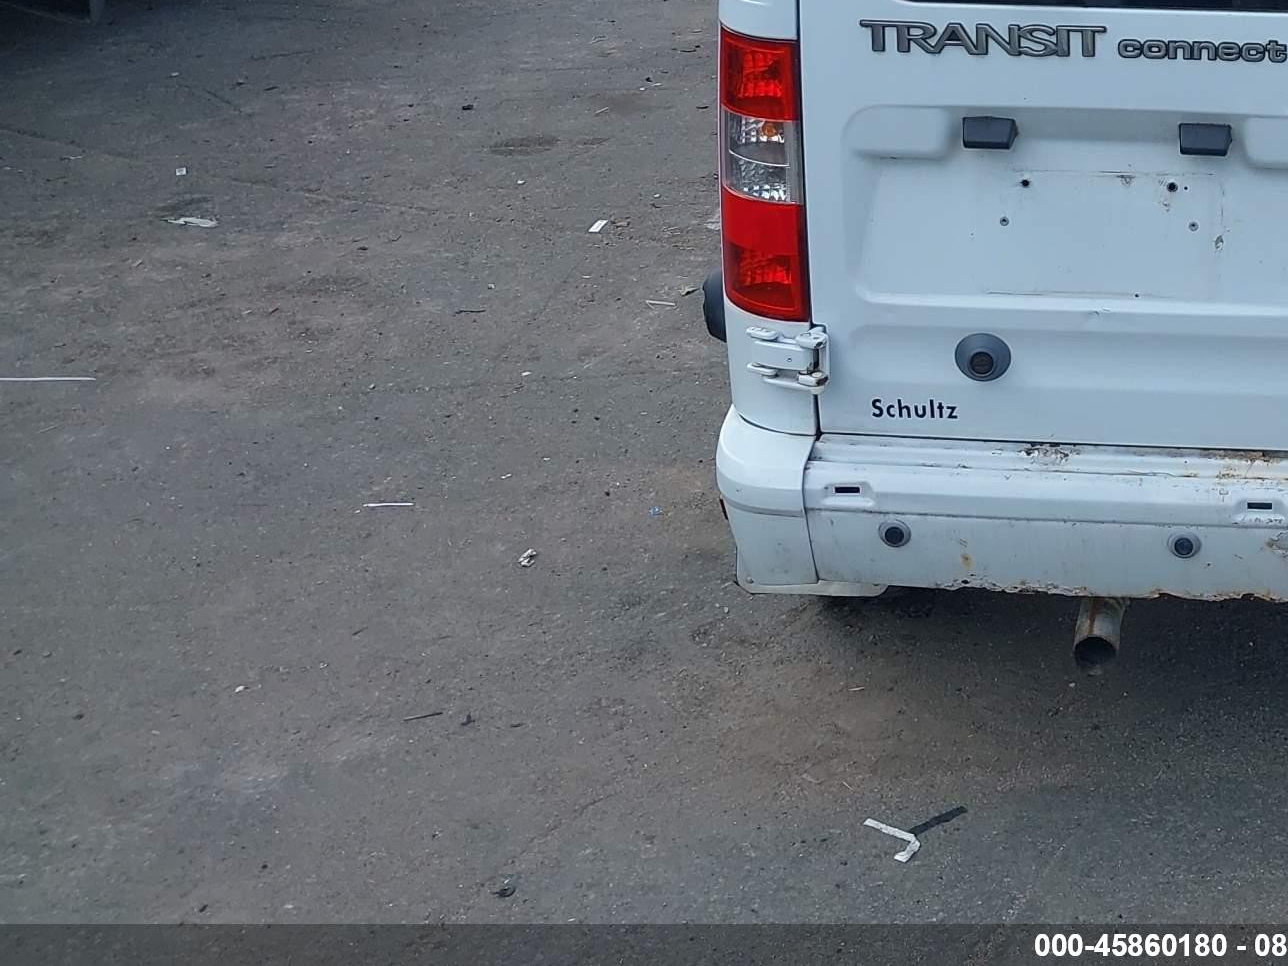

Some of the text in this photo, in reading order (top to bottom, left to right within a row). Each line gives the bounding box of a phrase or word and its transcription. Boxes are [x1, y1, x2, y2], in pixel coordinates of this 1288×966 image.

[859, 19, 1288, 63] TRANSIT connect
[871, 398, 958, 419] Schultz
